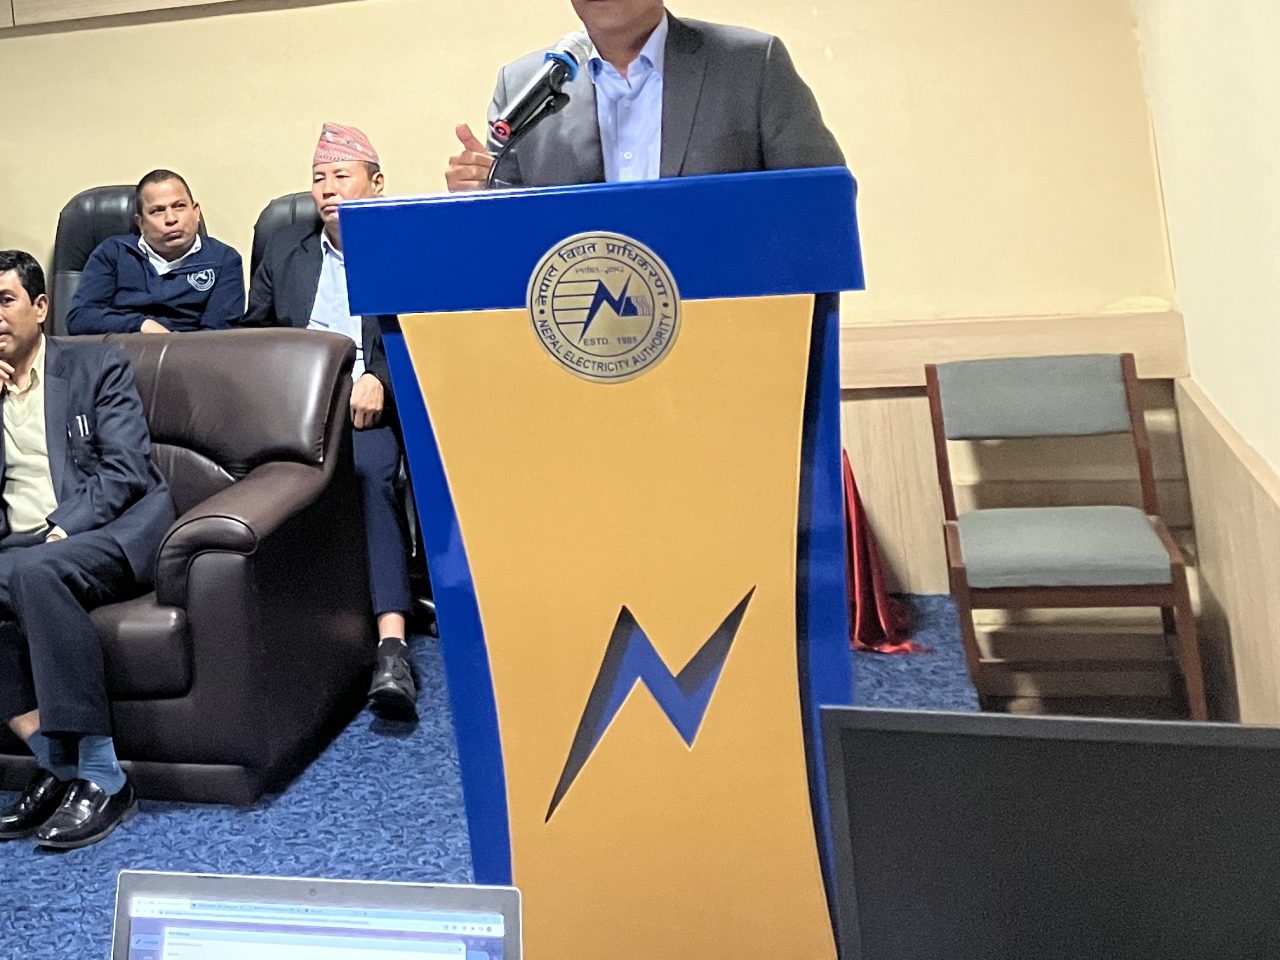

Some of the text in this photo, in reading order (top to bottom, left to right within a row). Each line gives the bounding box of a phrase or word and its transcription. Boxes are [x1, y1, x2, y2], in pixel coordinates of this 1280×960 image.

[535, 264, 559, 306] नेपाल
[606, 243, 668, 297] प्राधिकरण
[537, 314, 672, 373] NEPAL ELECTRICITY AUTHORITY
